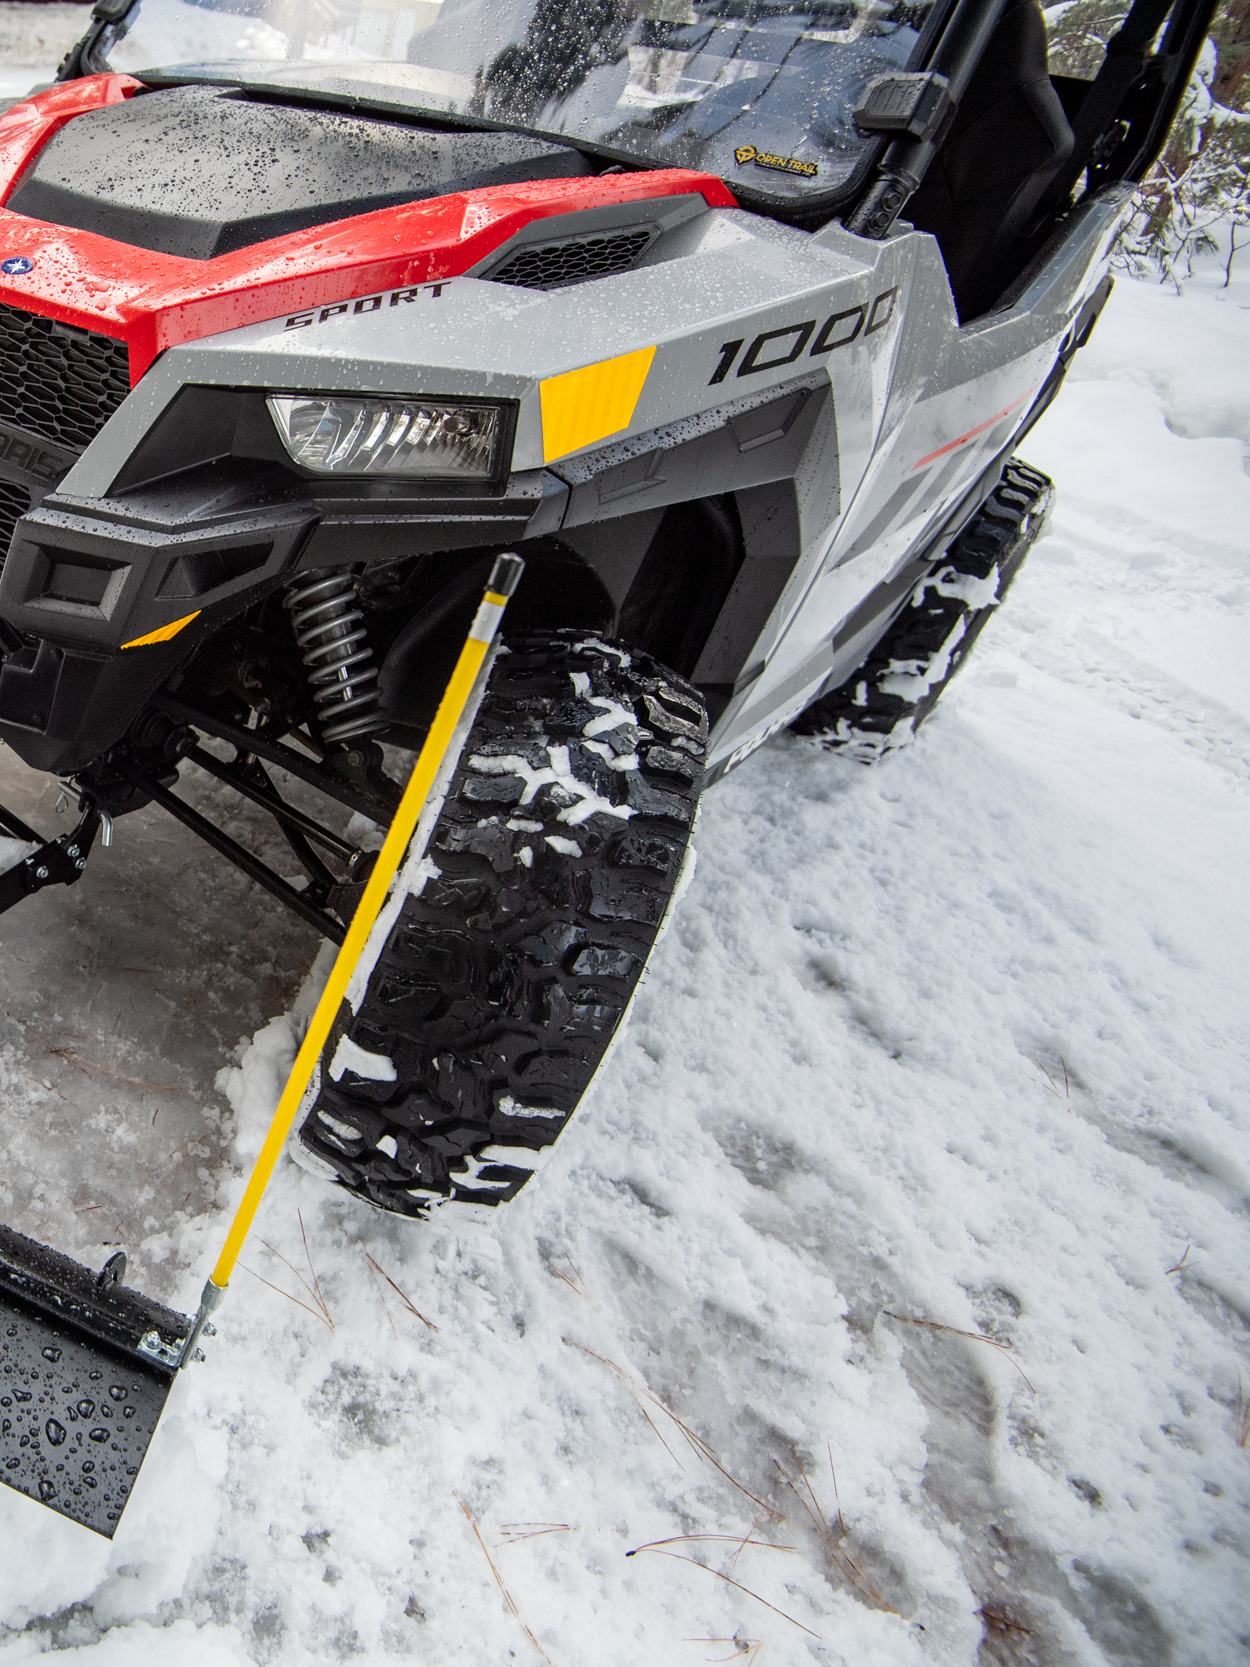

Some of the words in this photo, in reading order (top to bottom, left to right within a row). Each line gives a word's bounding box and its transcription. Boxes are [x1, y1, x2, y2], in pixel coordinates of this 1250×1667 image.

[756, 154, 787, 167] OPEN
[789, 159, 816, 174] TRAIL
[284, 281, 453, 332] SPORT
[707, 284, 899, 386] 1000
